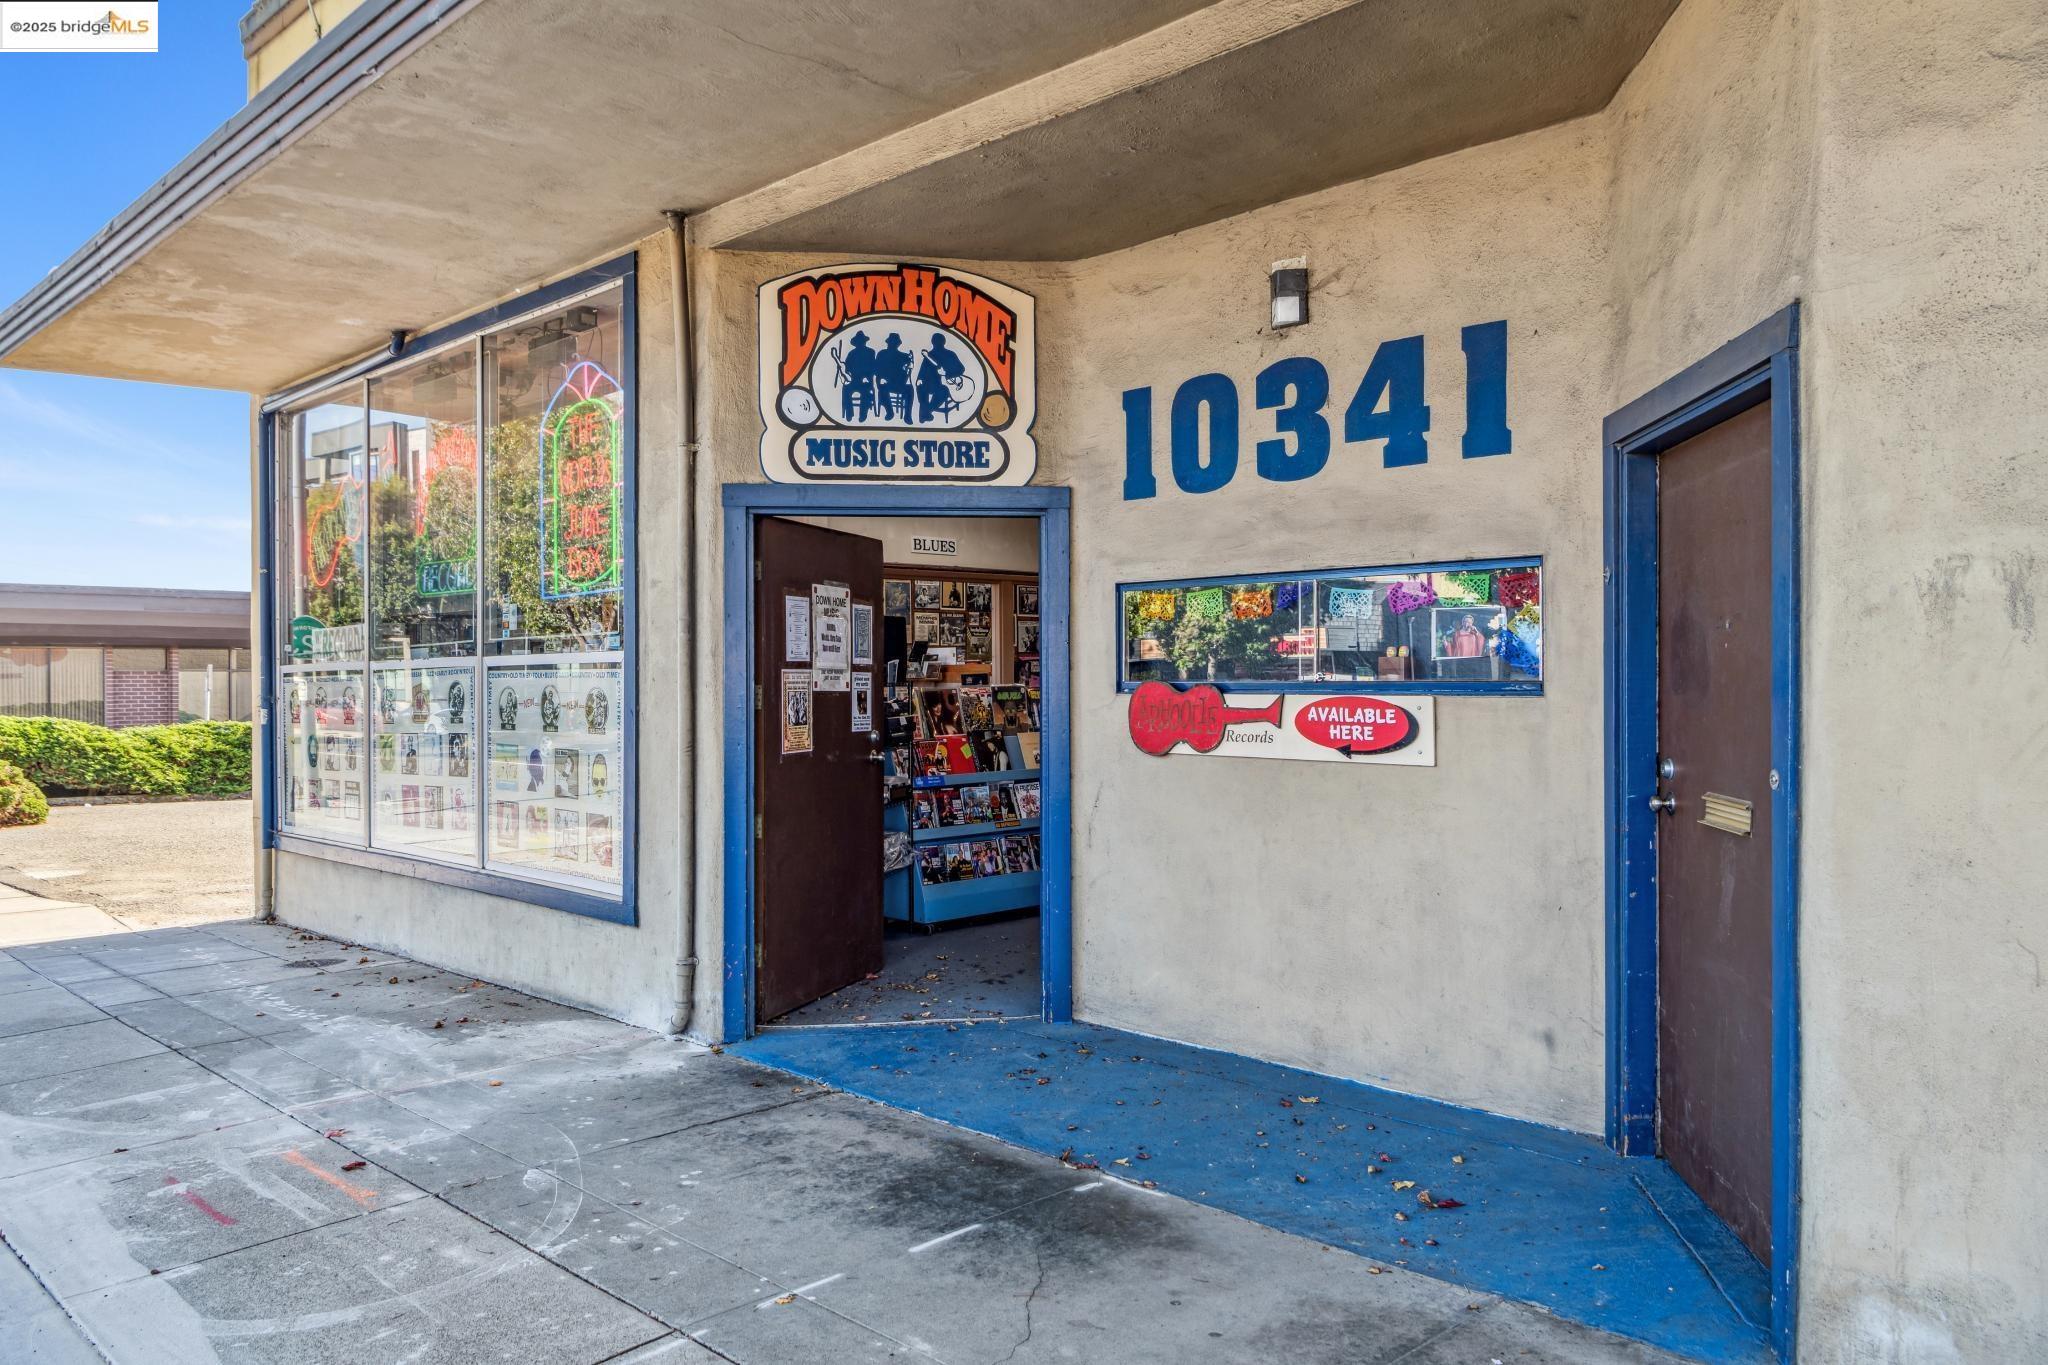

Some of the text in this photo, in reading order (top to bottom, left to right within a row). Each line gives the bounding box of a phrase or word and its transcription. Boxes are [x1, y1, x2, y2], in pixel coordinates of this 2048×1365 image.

[780, 266, 1014, 397] DOWN HOME
[1122, 319, 1512, 501] 10341
[566, 412, 601, 449] THE
[806, 438, 990, 469] MUSIC STORE
[564, 503, 609, 541] JUKE
[567, 543, 604, 579] BOX
[913, 538, 956, 553] BLUES
[815, 595, 847, 607] DOWN HOME
[1307, 706, 1396, 725] AVAILABLE
[1226, 730, 1274, 744] Records
[1329, 725, 1374, 742] HERE
